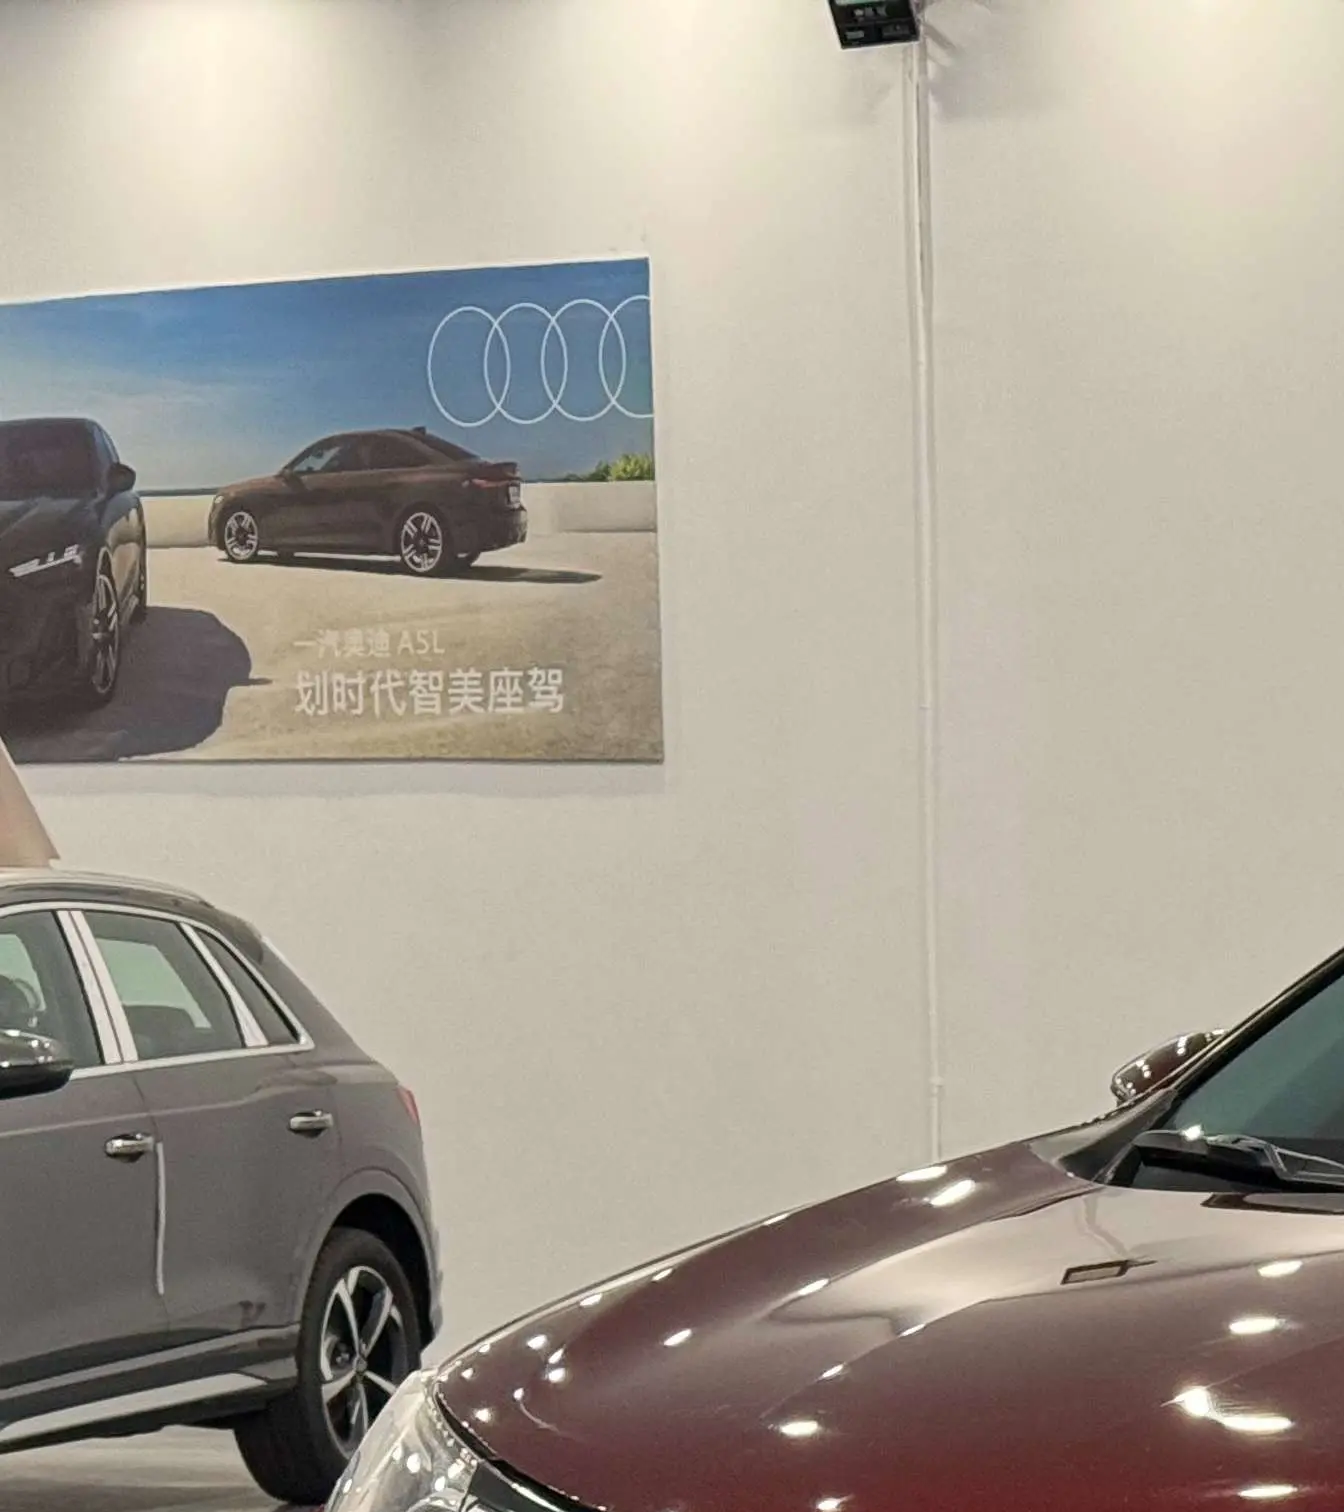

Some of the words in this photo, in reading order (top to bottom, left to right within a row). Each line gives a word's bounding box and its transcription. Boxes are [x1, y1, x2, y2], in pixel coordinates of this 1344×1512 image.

[293, 629, 391, 658] 一汽奥迪
[397, 629, 446, 655] A5L
[294, 668, 565, 717] 划时代智美座驾
